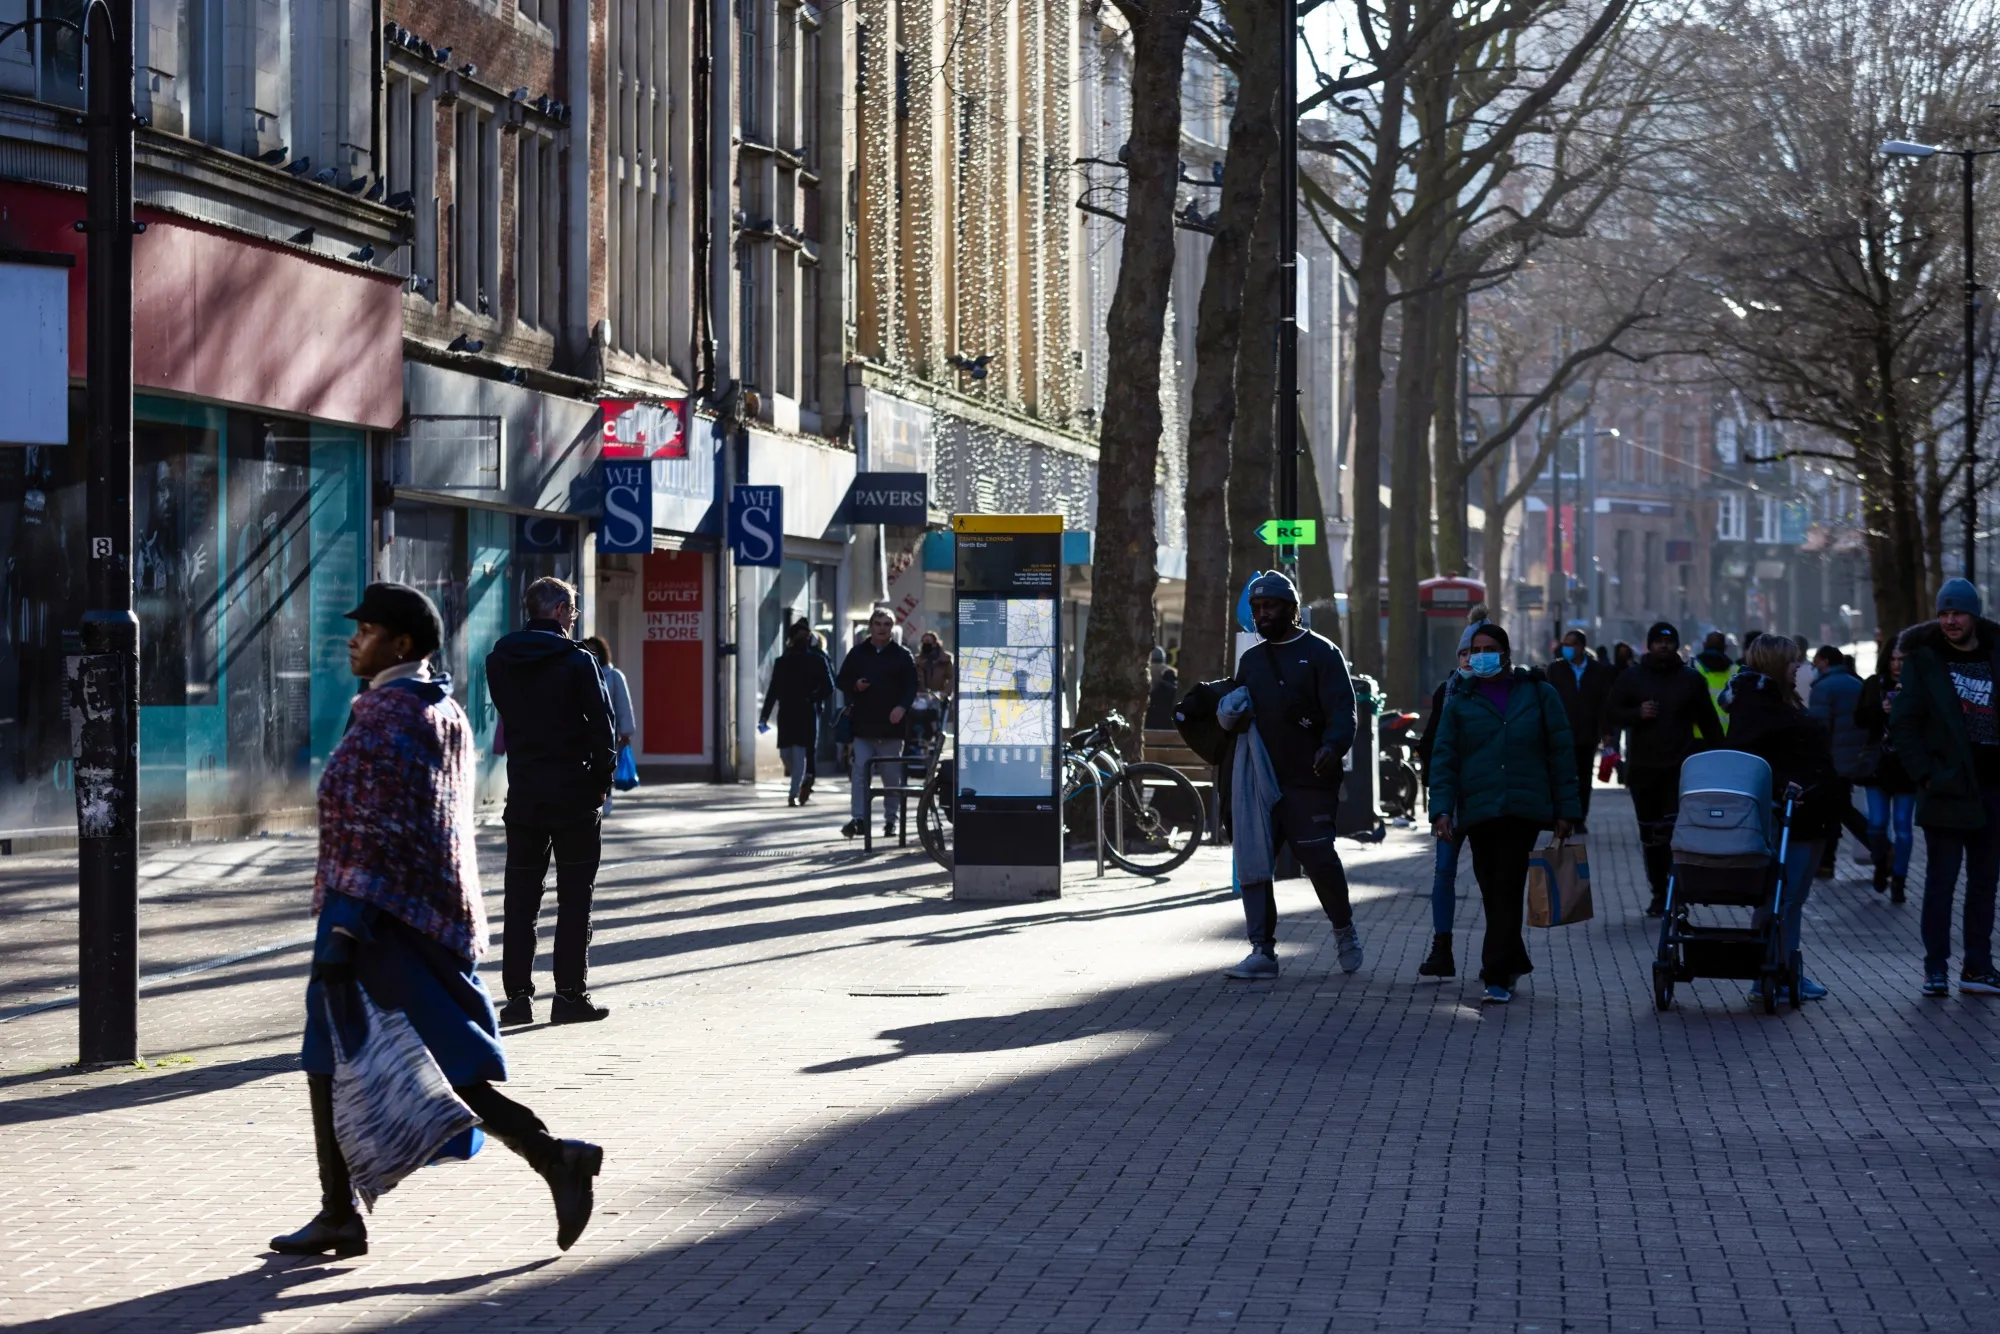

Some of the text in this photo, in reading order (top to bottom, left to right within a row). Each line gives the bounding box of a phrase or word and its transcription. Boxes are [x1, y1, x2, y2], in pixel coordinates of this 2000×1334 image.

[605, 467, 643, 485] WH
[741, 490, 774, 507] WH
[855, 490, 924, 507] PAVERS
[604, 486, 644, 547] S
[740, 506, 774, 561] S
[1276, 527, 1303, 538] RC
[96, 537, 110, 556] 8
[647, 590, 699, 601] OUTLET
[647, 613, 700, 625] IN THIS
[647, 627, 699, 639] STORE
[1954, 685, 1990, 706] TREFA
